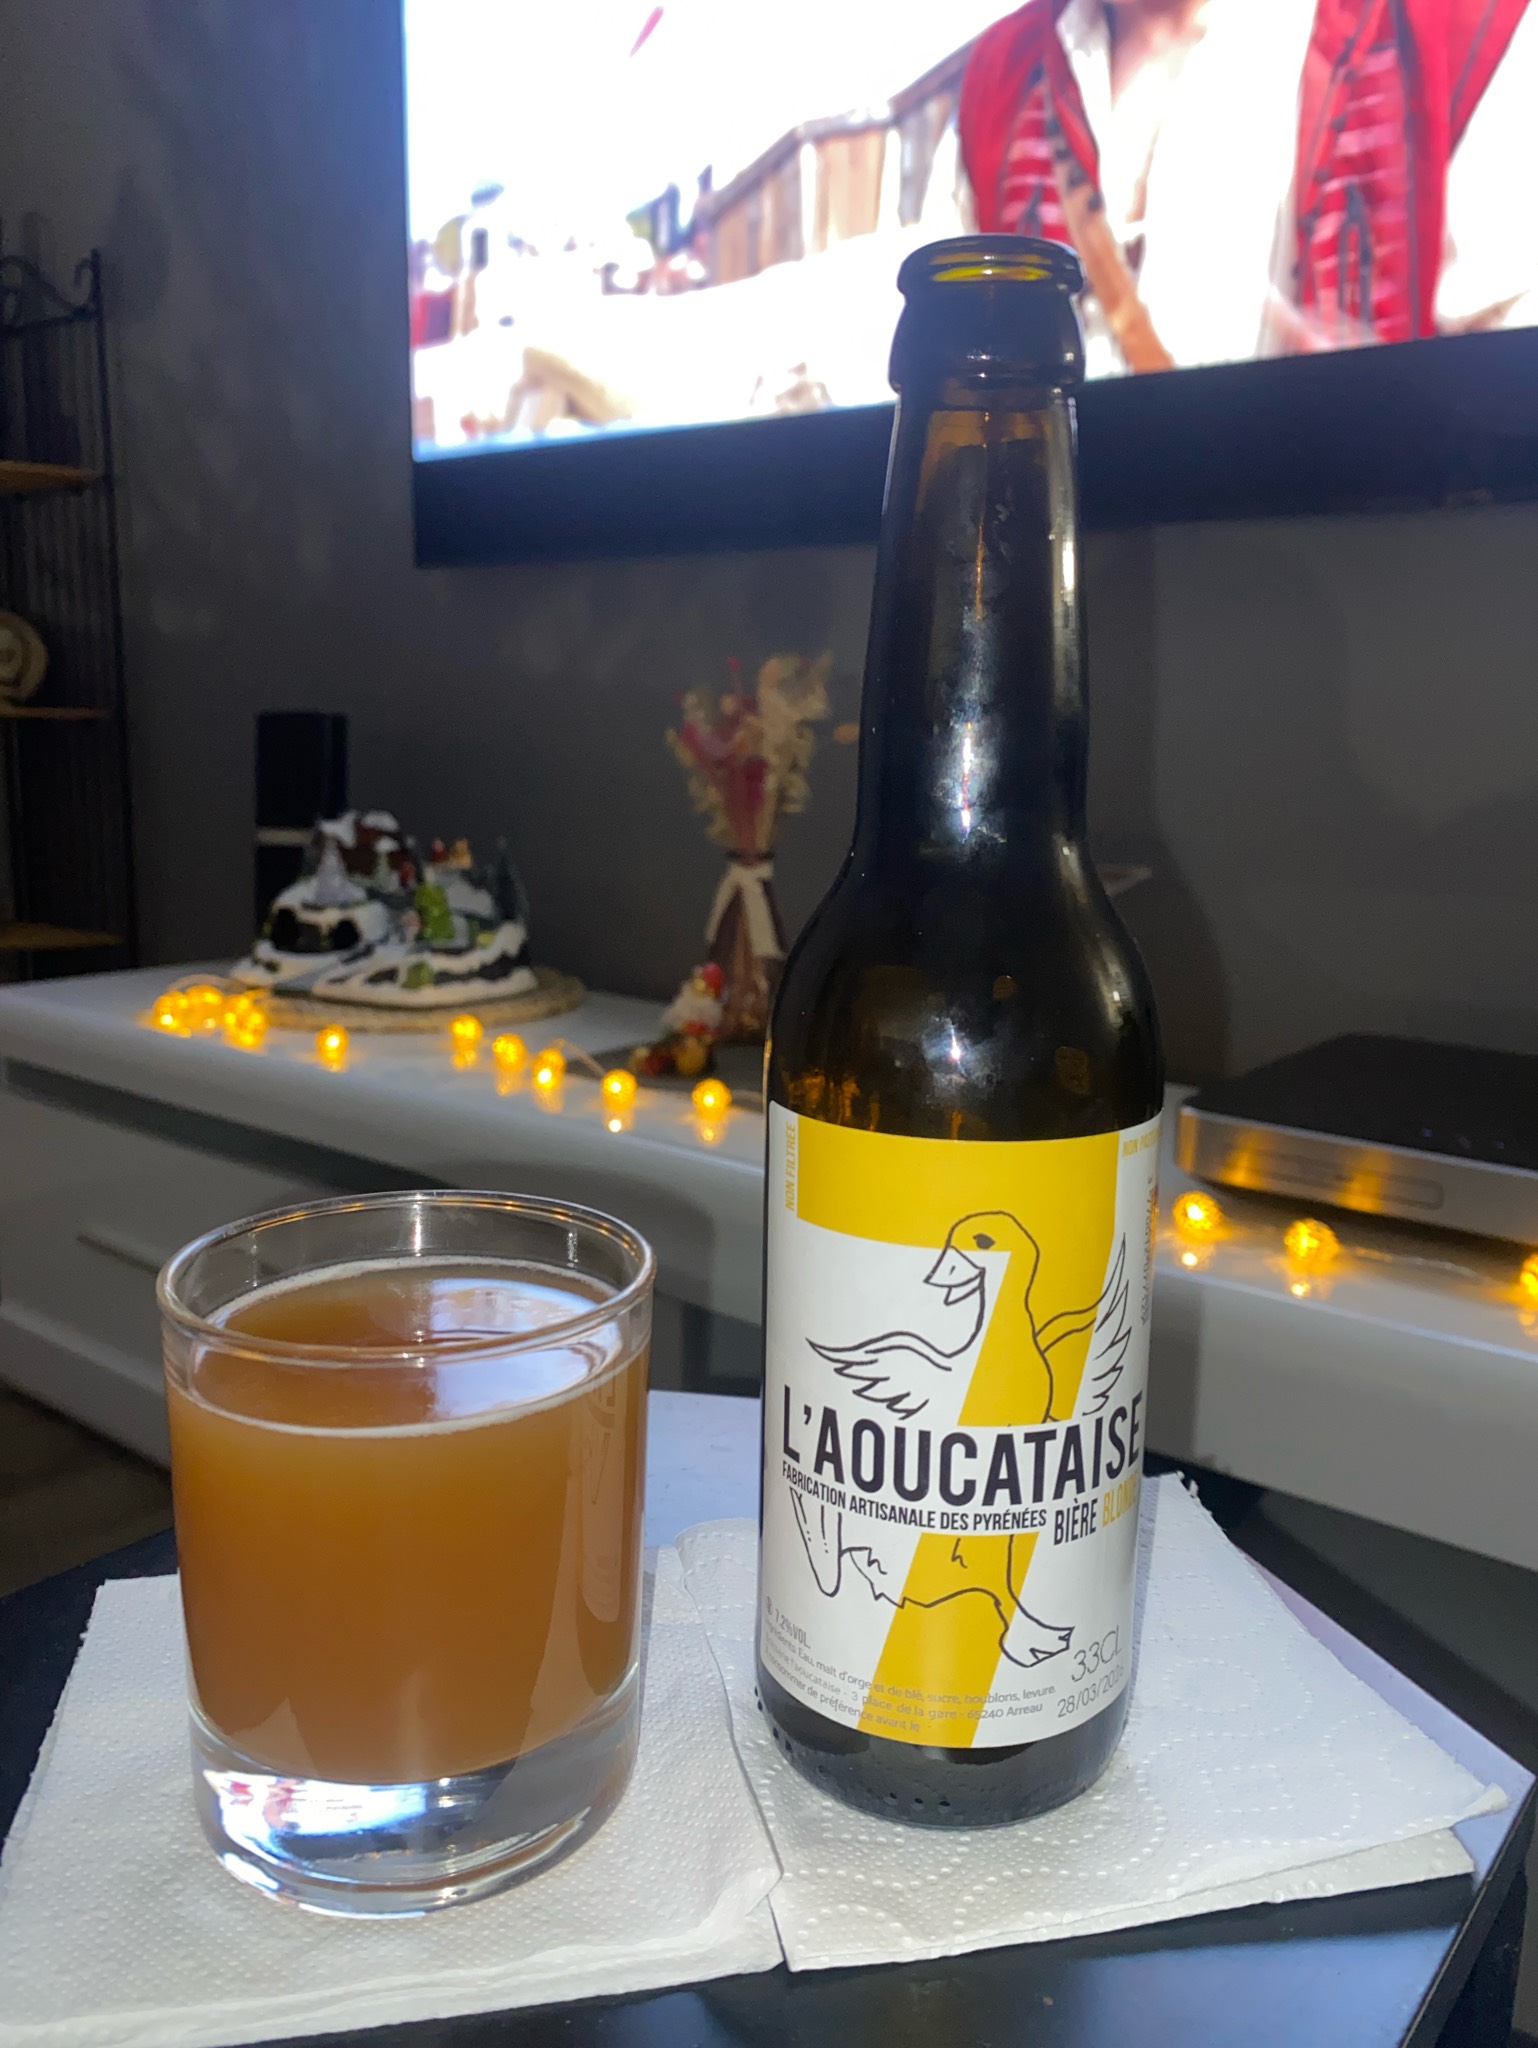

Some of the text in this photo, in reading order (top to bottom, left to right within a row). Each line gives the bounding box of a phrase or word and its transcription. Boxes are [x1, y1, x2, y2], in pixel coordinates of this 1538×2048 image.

[783, 1385, 1142, 1506] L'AOUCATAISE
[782, 1459, 1047, 1531] FABRICATION ARTISANALE DES PYRÉNÉES
[1054, 1497, 1098, 1546] BIÈRE
[807, 1685, 819, 1698] de
[816, 1661, 837, 1677] malt
[839, 1671, 871, 1690] d'orge
[874, 1683, 884, 1693] et
[888, 1685, 903, 1697] de
[851, 1691, 858, 1701] 3
[862, 1695, 892, 1709] place
[896, 1701, 911, 1715] de
[914, 1704, 924, 1717] la
[928, 1709, 957, 1720] gare
[967, 1708, 1003, 1720] 65240
[1006, 1703, 1043, 1717] Arreau
